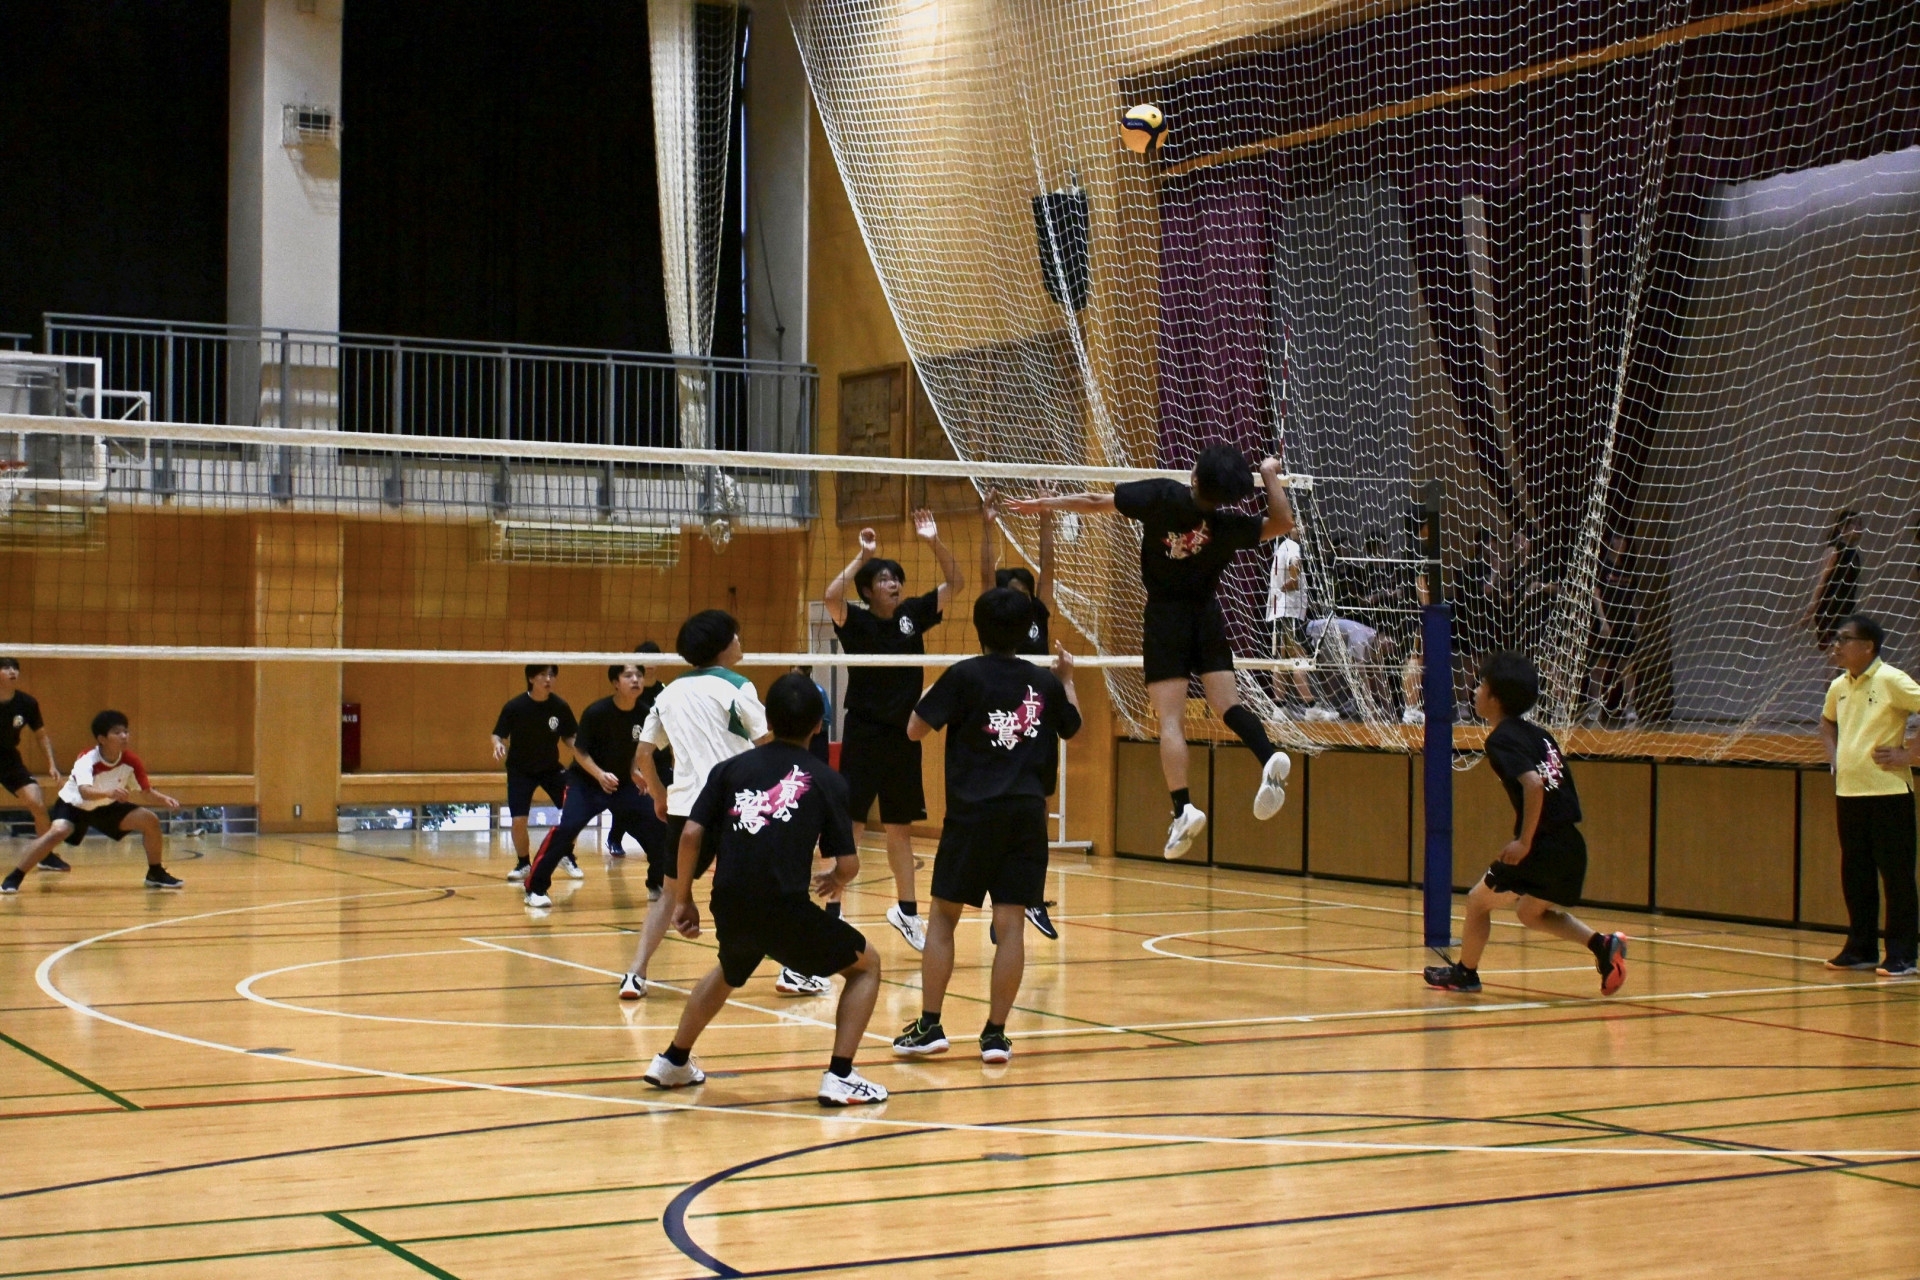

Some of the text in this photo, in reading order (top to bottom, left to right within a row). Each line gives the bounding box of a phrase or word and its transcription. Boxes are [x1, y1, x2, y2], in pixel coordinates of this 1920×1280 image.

[987, 709, 1022, 751] 鷲
[1022, 684, 1042, 738] 上見ぬ
[732, 788, 772, 835] 鷲
[772, 764, 805, 823] 上見ぬ
